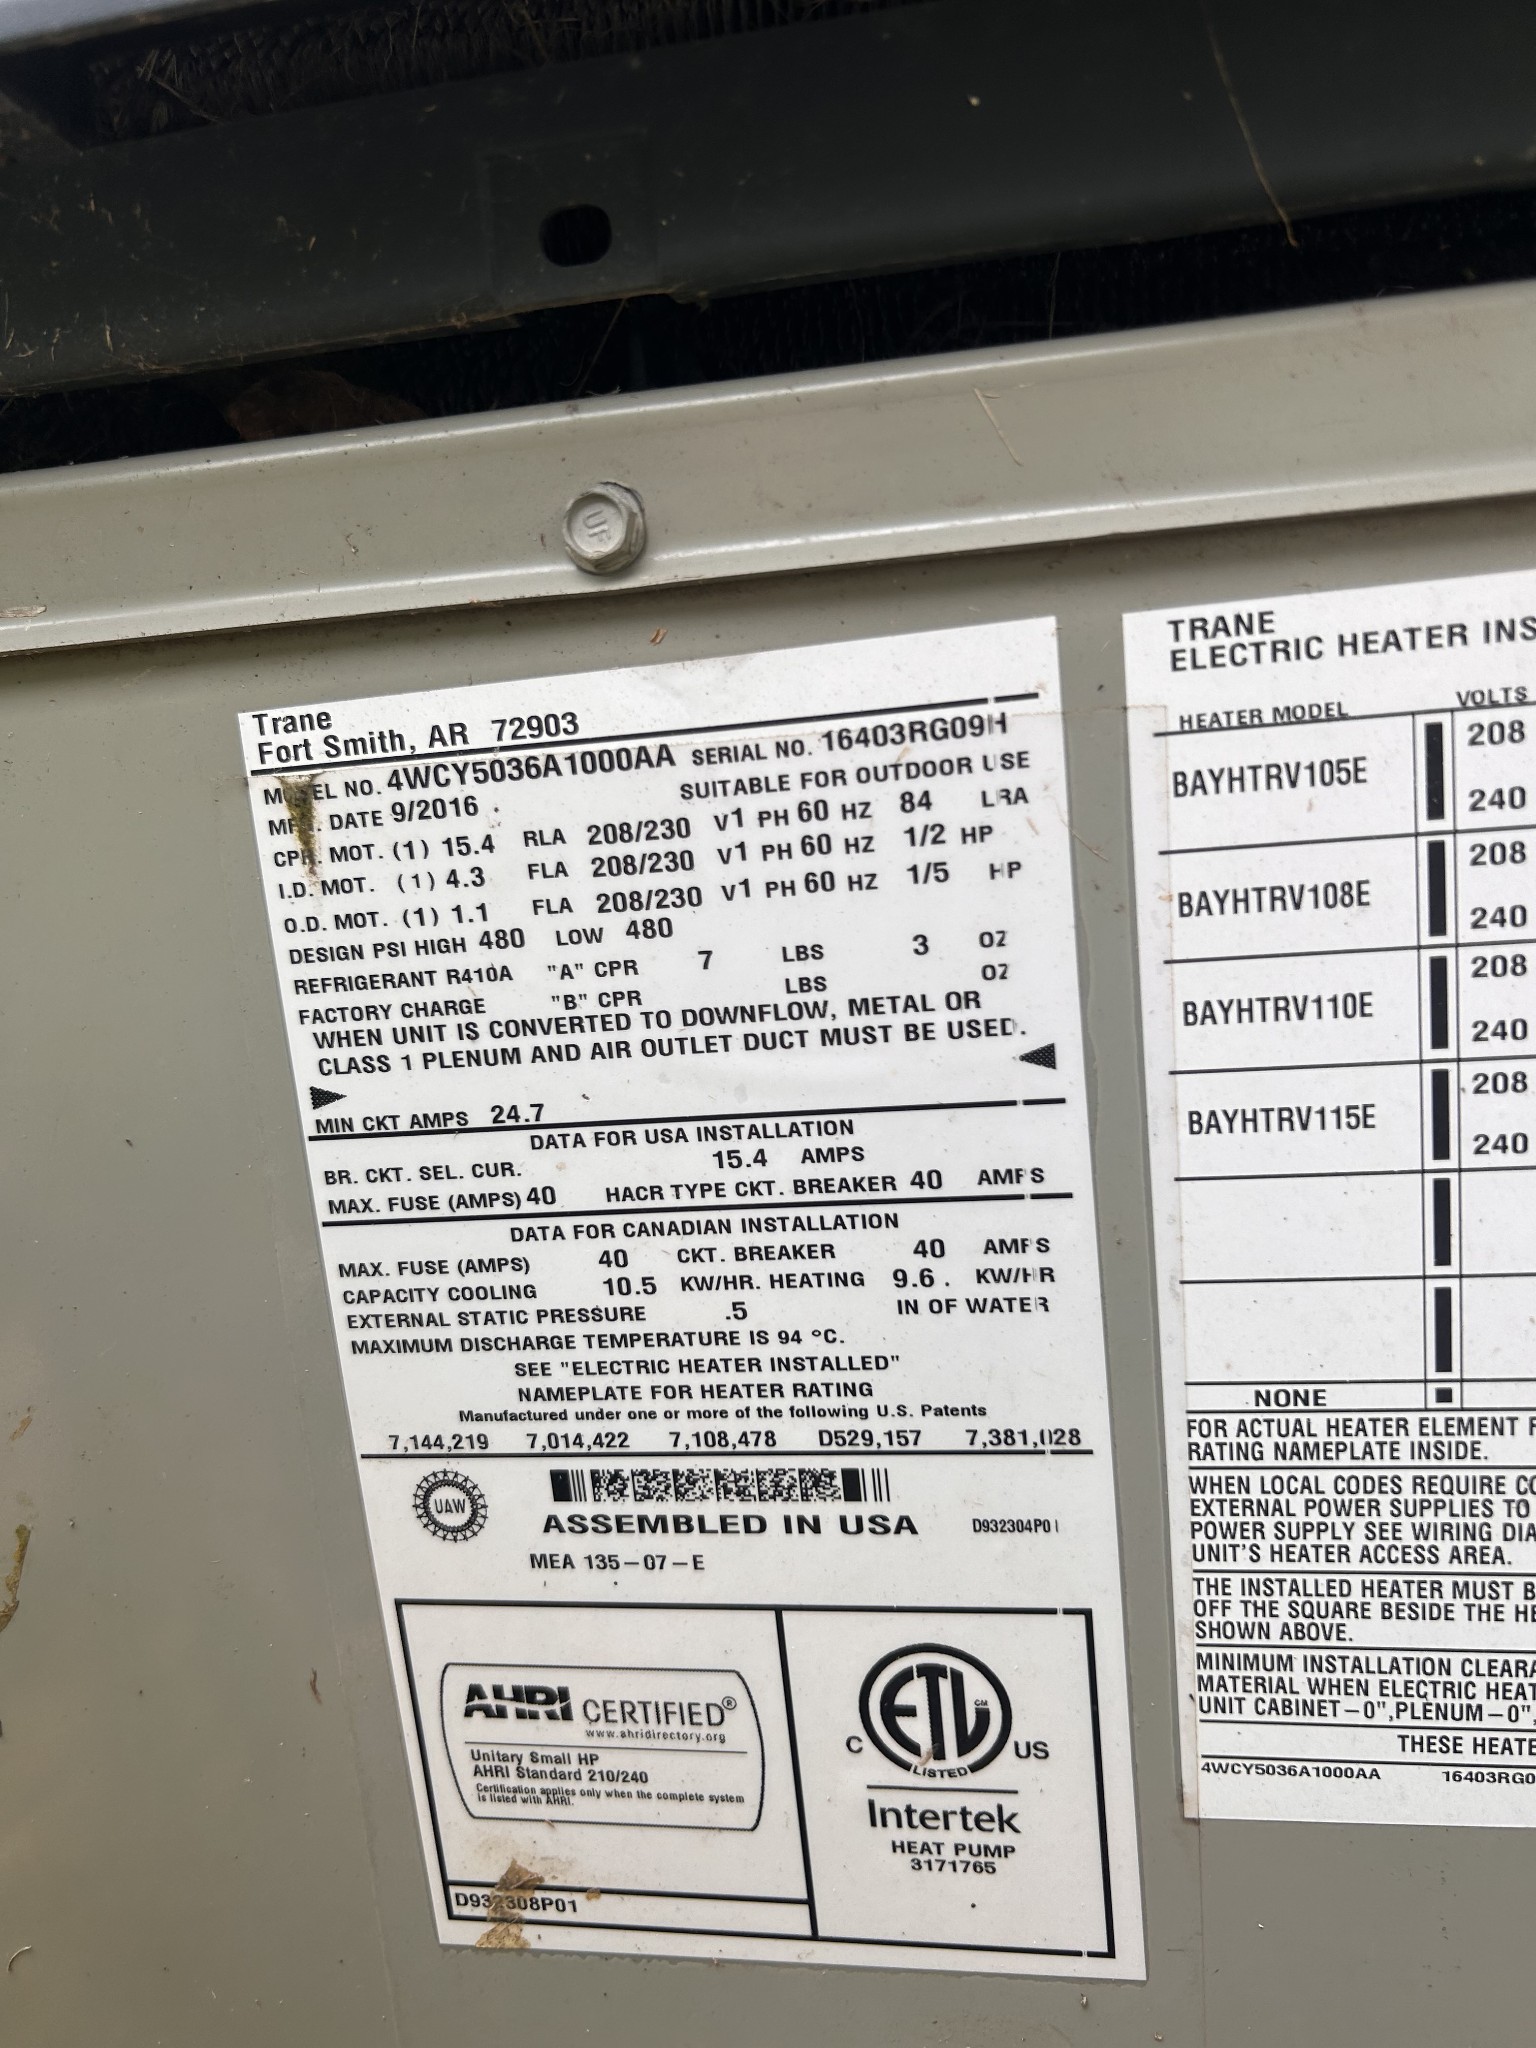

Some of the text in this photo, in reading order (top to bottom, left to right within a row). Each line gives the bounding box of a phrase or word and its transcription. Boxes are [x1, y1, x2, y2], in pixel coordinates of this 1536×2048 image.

[1167, 610, 1275, 642] TRANE
[1170, 635, 1323, 672] ELECTRIC
[1337, 622, 1468, 657] HEATER
[1455, 685, 1528, 707] VOLTS
[251, 711, 332, 736] Trane
[1179, 701, 1349, 730] HEATER MODEL
[257, 711, 579, 765] Fort Smith, AR 72903
[691, 711, 1007, 766] SERIAL NO. 16403RG09H
[1468, 719, 1525, 747] 208
[344, 743, 676, 798] NO. 4WCY5036A1000AA
[679, 750, 1030, 801] SUITABLE FOR OUTDOOR USE
[1173, 756, 1367, 798] BAYHTRV105E
[1469, 785, 1526, 812] 240
[329, 795, 479, 831] DATE 9/2016
[522, 789, 933, 848] RLA 208/230 60 84
[441, 833, 495, 857] 15.4
[1178, 879, 1370, 918] BAYHTRV108E
[288, 917, 674, 965] DESIGN PSI HIGH 480 LOW 480
[293, 970, 437, 995] REFRIGERANT
[446, 963, 514, 985] R410A
[594, 959, 639, 978] CPR
[298, 997, 486, 1025] FACTORY CHARGE
[312, 990, 982, 1049] WHEN UNIT IS CONVERTED TO DOWNFLOW, METAL OR
[1183, 991, 1373, 1027] BAYHTRV110E
[318, 1054, 392, 1077] CLASS
[422, 1047, 522, 1070] PLENUM
[530, 1043, 581, 1064] AND
[590, 1040, 632, 1060] AIR
[640, 1034, 733, 1058] OUTLET
[743, 1029, 809, 1051] DUCT
[820, 1024, 892, 1047] MUST
[903, 1022, 936, 1042] BE
[315, 1103, 545, 1134] MIN CKT AMPS 24.7
[1188, 1103, 1376, 1135] BAYHTRV115E
[622, 1212, 899, 1238] CANADIAN INSTALLATION
[342, 1271, 865, 1305] CAPACITY COOLING 10.5 KW/HR. HEATING
[350, 1329, 803, 1355] MAXIMUM DISCHARGE TEMPERATURE IS 94
[560, 1355, 899, 1376] "ELECTRIC HEATER INSTALLED"
[517, 1381, 873, 1402] NAMEPLATE RATING
[1254, 1388, 1327, 1408] NONE
[458, 1404, 987, 1422] Manufactured under one or more of the following U.S. Patents
[668, 1429, 777, 1451] 7,108,478
[818, 1429, 922, 1449] D529,157
[1186, 1416, 1519, 1439] FOR ACTUAL HEATER ELEMENT
[388, 1433, 489, 1453] 7,144,219
[526, 1431, 630, 1452] 7,014,422
[1187, 1439, 1488, 1462] RATING NAMEPLATE INSIDE.
[1187, 1474, 1506, 1496] WHEN LOCAL CODES REQUIRE
[434, 1498, 466, 1514] UAW
[1189, 1497, 1530, 1518] EXTERNAL POWER SUPPLIES TO
[542, 1513, 919, 1536] ASSEMBLED IN USA
[529, 1553, 576, 1570] MEA
[1240, 1577, 1514, 1601] INSTALLED HEATER MUST
[1194, 1620, 1353, 1642] SHOWN ABOVE.
[1196, 1652, 1451, 1677] MINIMUM INSTALLATION
[464, 1683, 573, 1721] AHRI
[470, 1748, 600, 1766] Unitary Small HP
[1013, 1740, 1050, 1760] US
[473, 1764, 649, 1784] AHRI Standard 210/240
[912, 1764, 968, 1779] LISTED
[1200, 1761, 1381, 1780] 4WCY5036A1000AA
[579, 1788, 745, 1804] only when the complete system
[867, 1798, 1021, 1834] Intertek
[891, 1840, 1016, 1859] HEAT PUMP
[910, 1857, 997, 1875] 3171765
